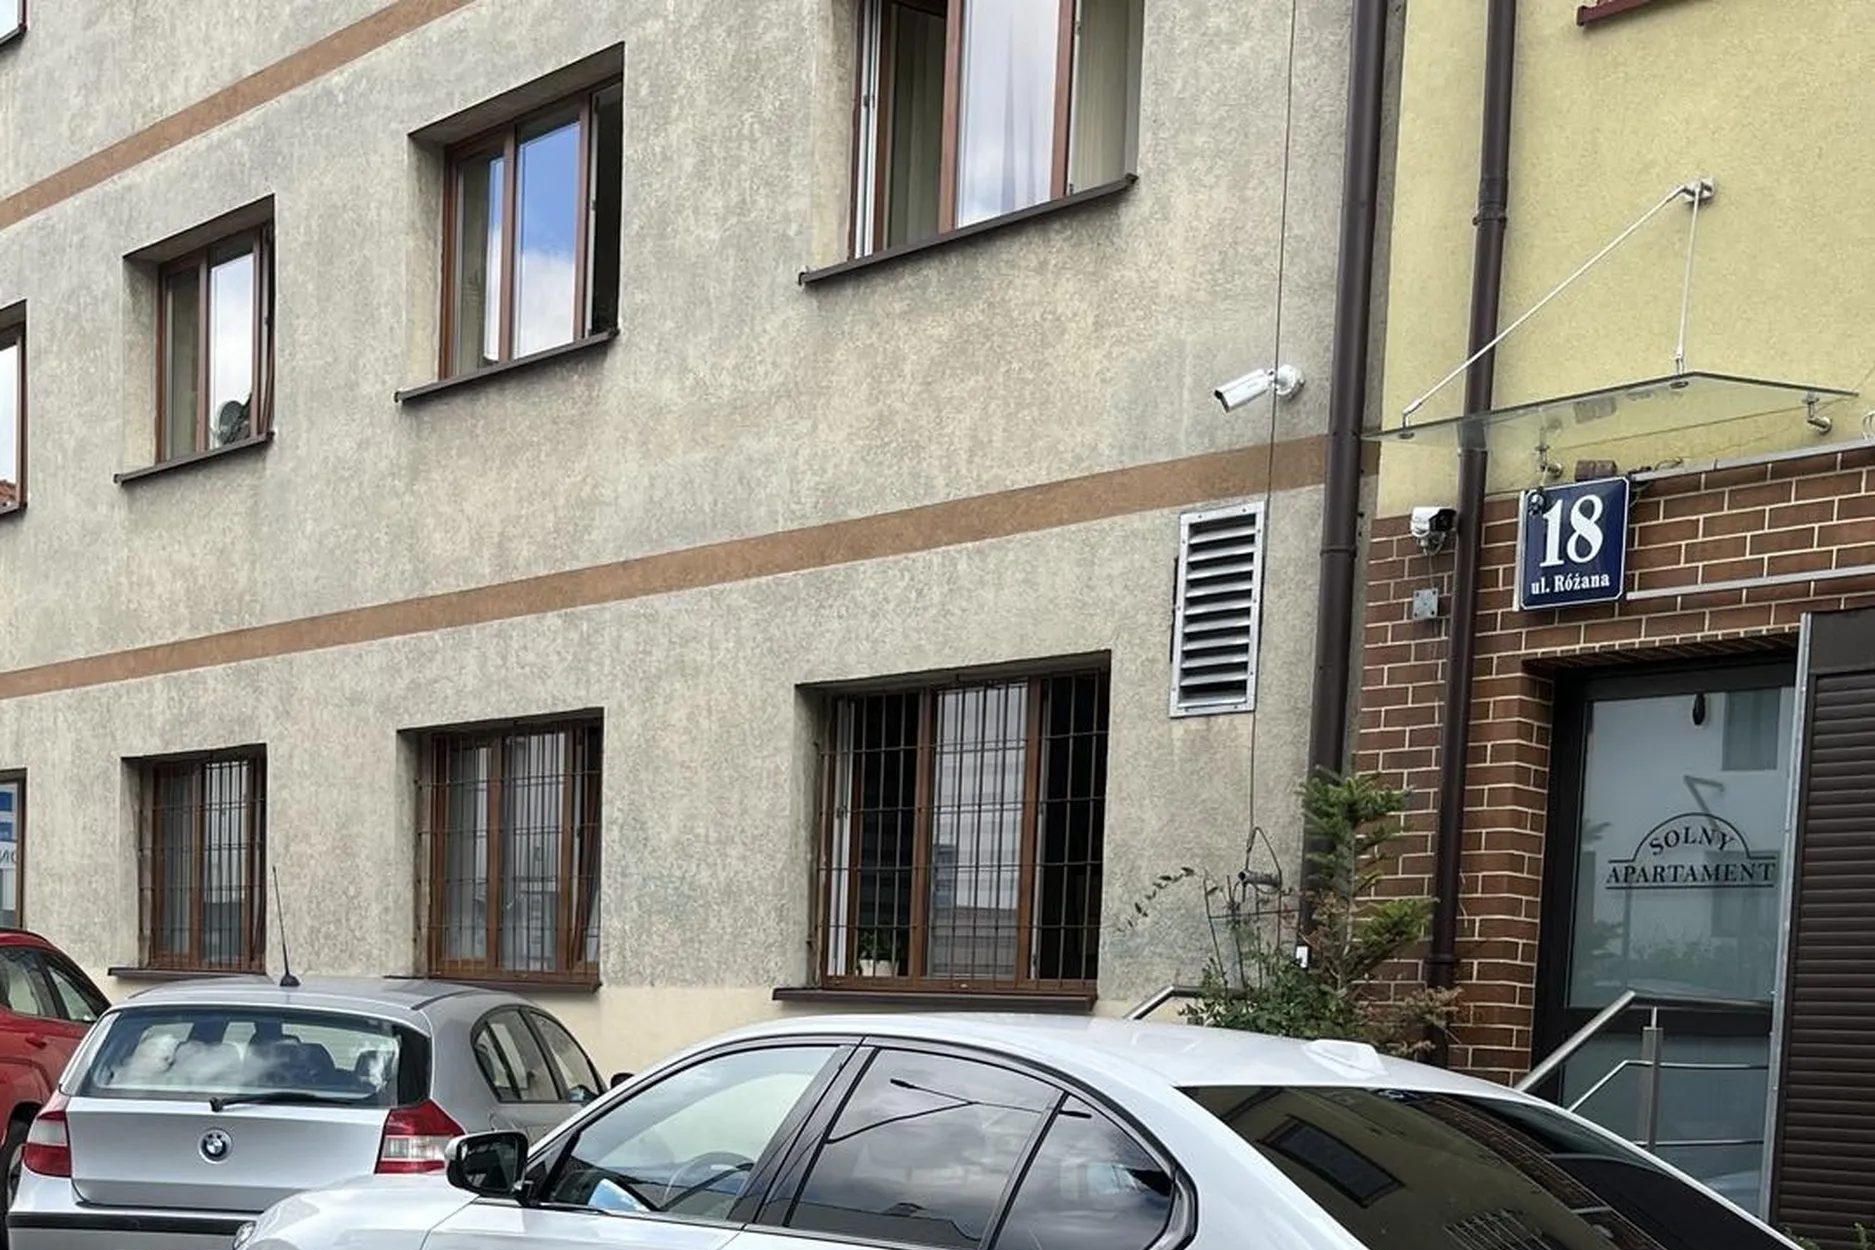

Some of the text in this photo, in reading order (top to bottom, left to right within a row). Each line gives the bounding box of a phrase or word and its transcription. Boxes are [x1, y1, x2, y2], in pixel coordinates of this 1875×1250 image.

[1540, 494, 1604, 567] 18
[1531, 573, 1610, 594] ul. Różana
[1649, 826, 1735, 855] SOLNY
[1606, 863, 1776, 883] APARTAMENT
